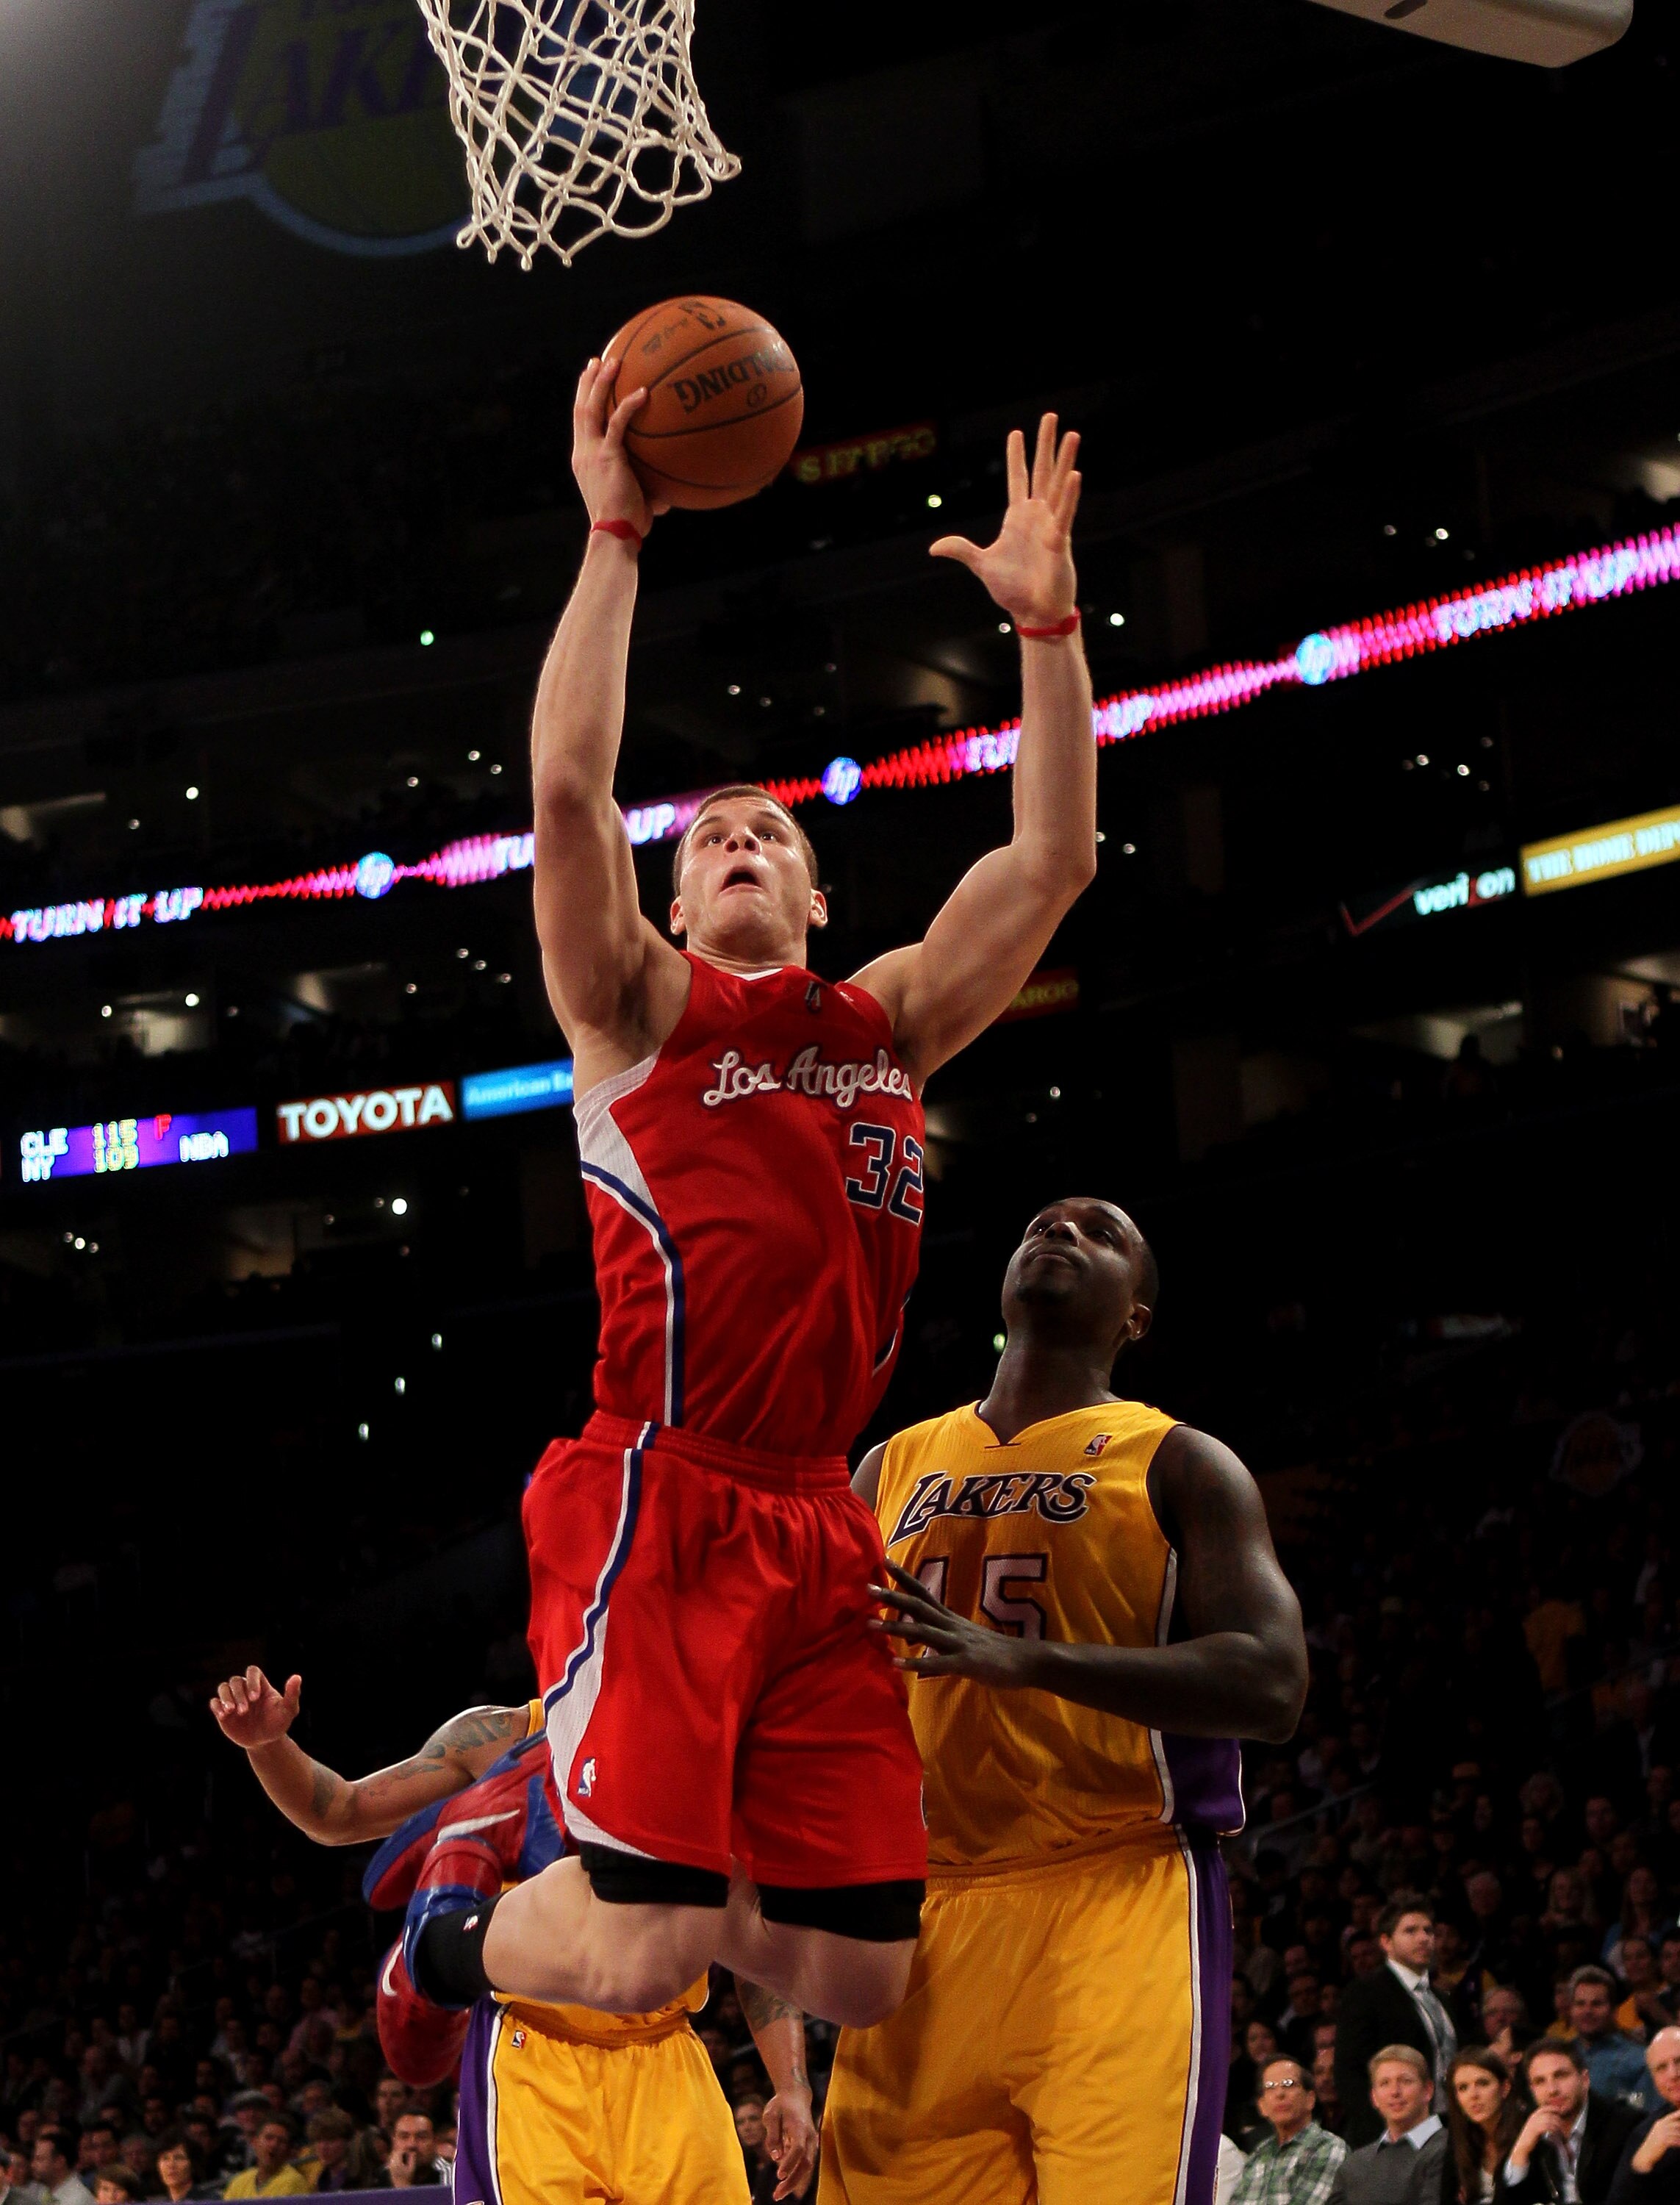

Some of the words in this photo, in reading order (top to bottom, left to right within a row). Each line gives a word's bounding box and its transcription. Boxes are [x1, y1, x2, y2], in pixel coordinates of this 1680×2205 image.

[11, 898, 104, 943] TURN
[154, 886, 204, 923] UP
[703, 1050, 782, 1107] Los
[786, 1045, 913, 1108] Angeles
[21, 1127, 69, 1158] CLE
[93, 1119, 138, 1150] 115
[278, 1084, 454, 1141] TOYOTA
[21, 1155, 55, 1182] NY
[179, 1131, 229, 1162] NBA
[846, 1122, 925, 1227] 32
[888, 1470, 1096, 1546] LAKERS
[902, 1552, 1048, 1679] 15
